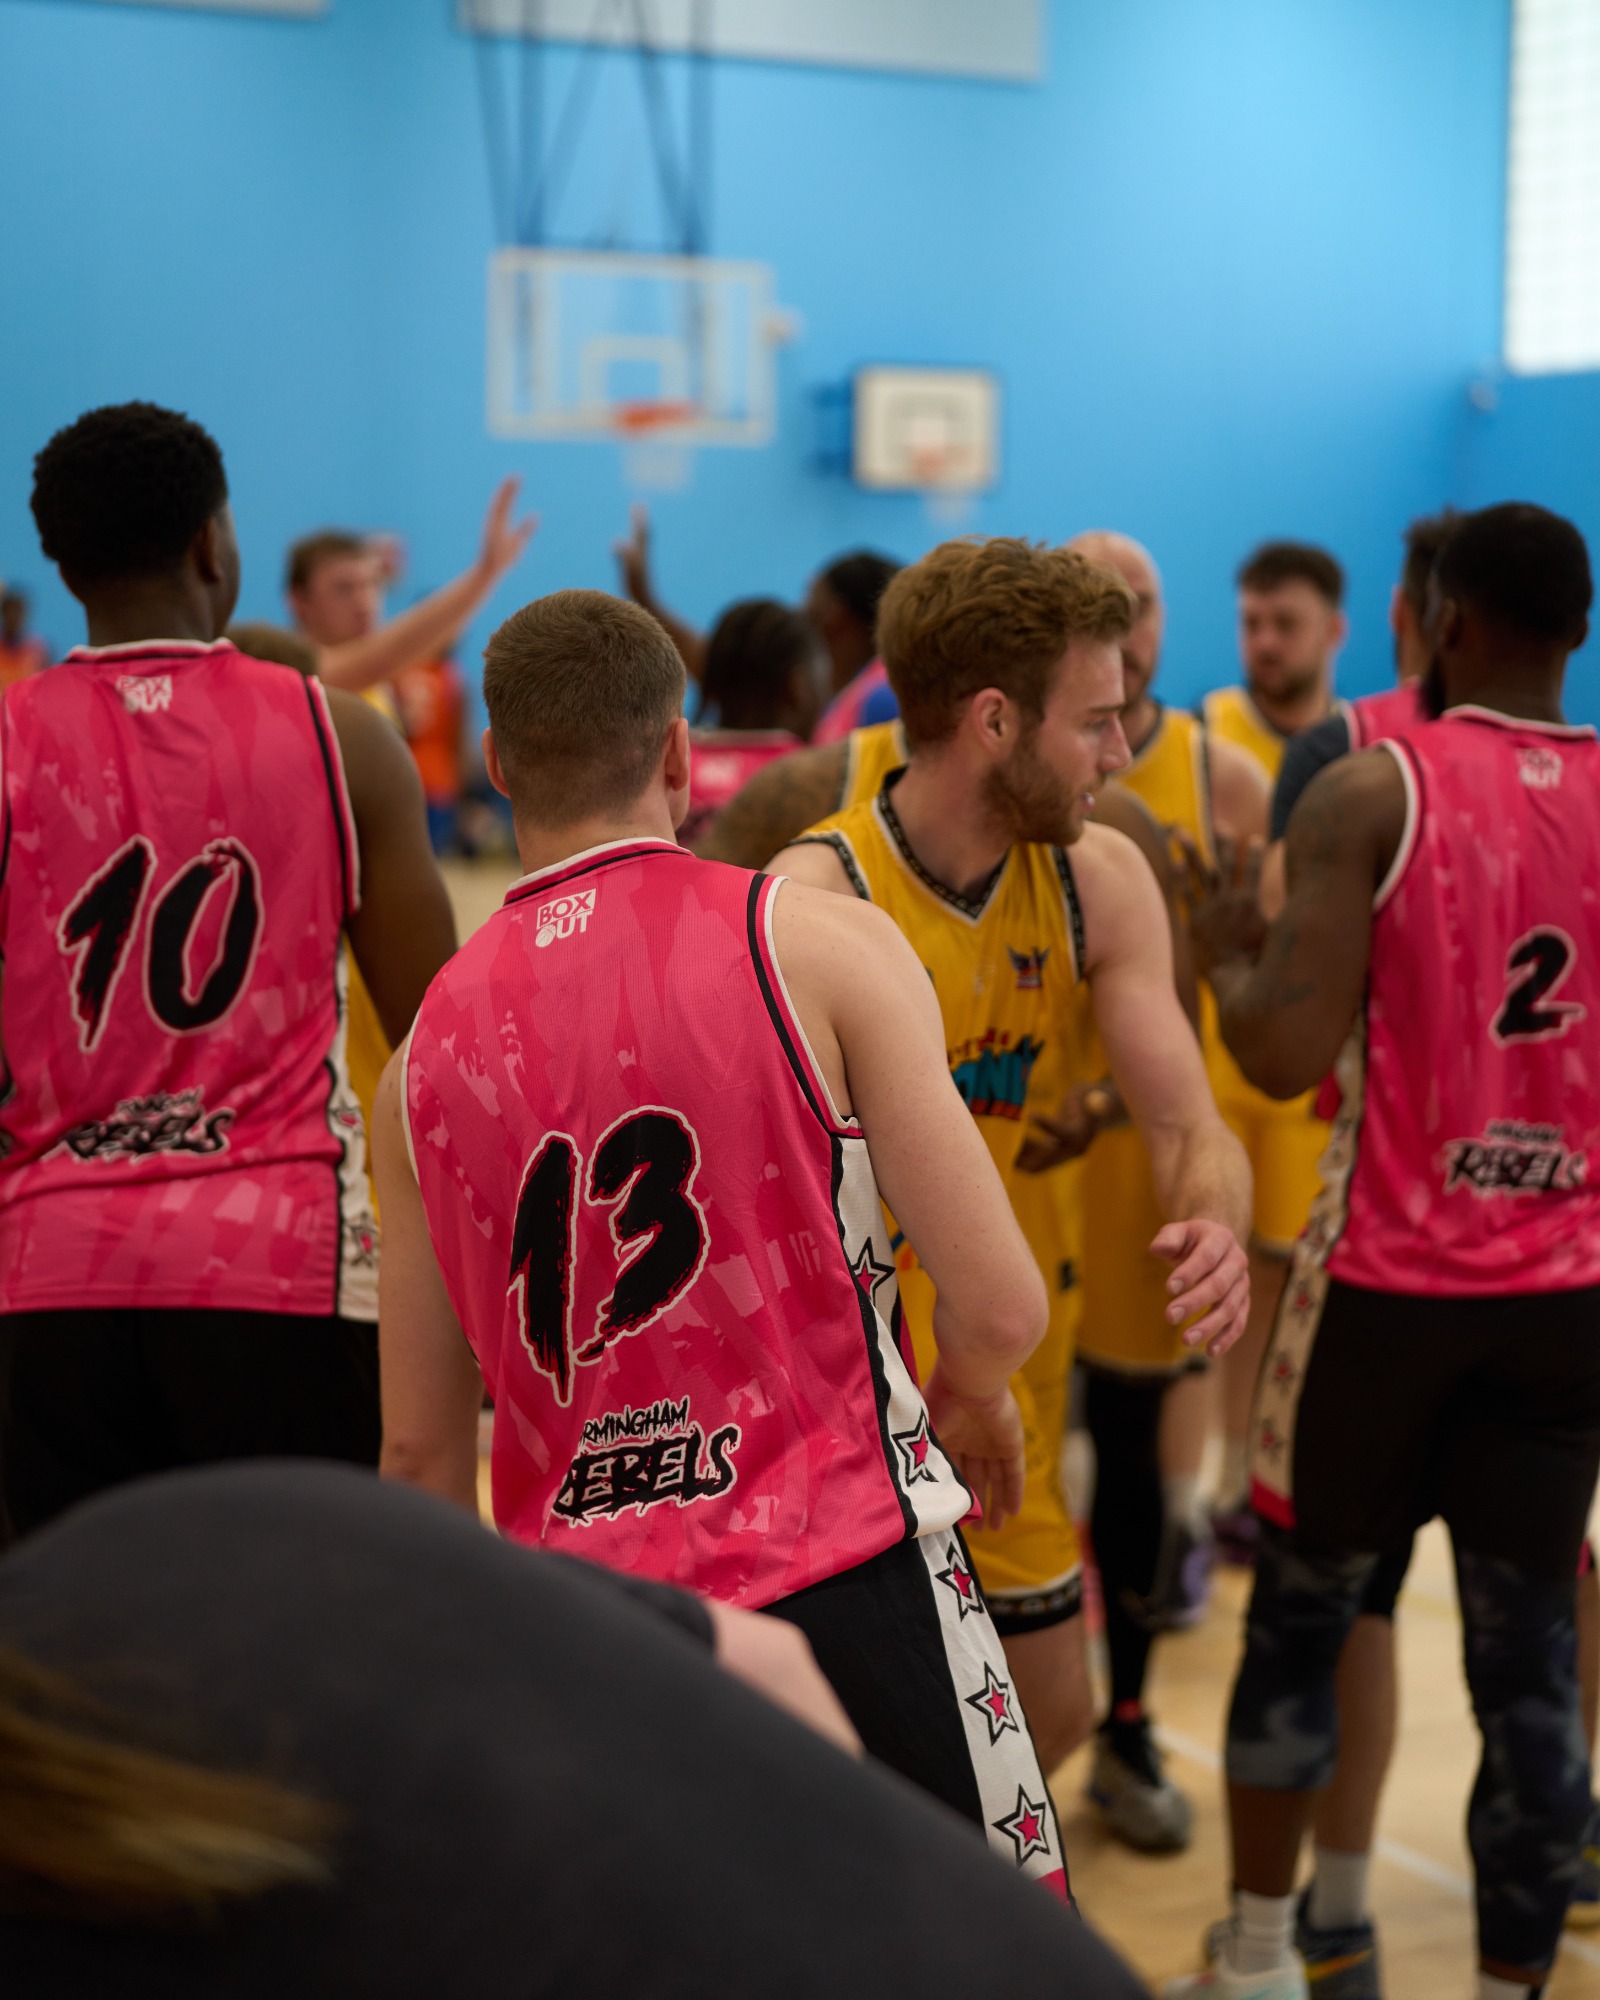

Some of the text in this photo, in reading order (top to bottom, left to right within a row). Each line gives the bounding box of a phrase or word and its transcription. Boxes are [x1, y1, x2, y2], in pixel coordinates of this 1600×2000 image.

[56, 834, 265, 1053] 10
[538, 891, 594, 927] BOX
[1488, 924, 1587, 1048] 2
[506, 1105, 712, 1407] 13
[579, 1395, 690, 1447] RMINGHAM
